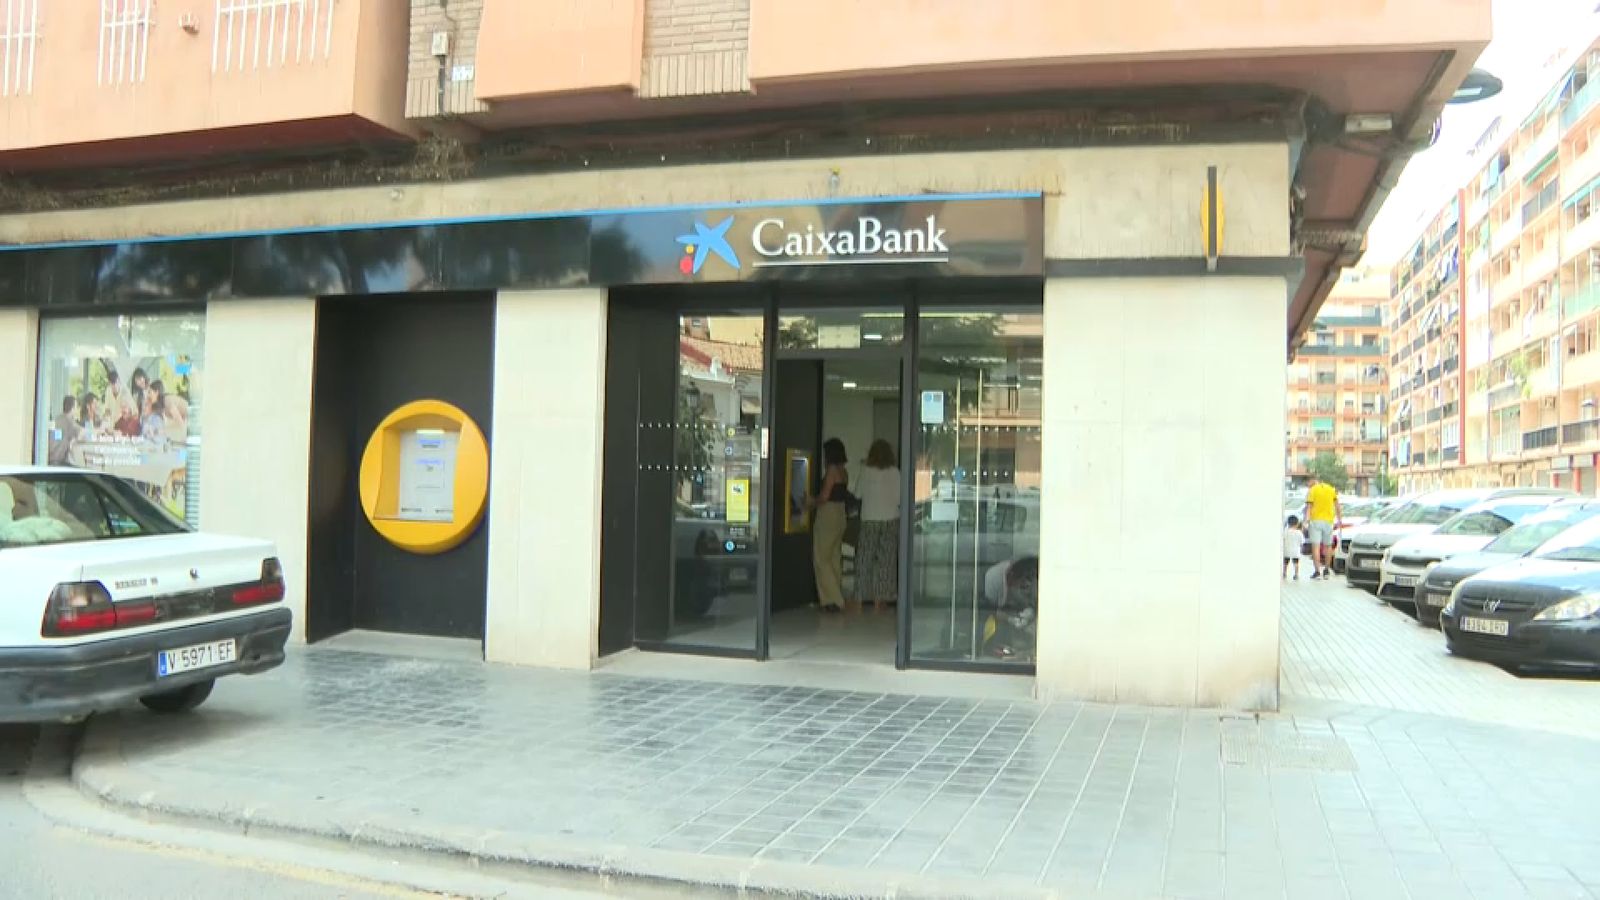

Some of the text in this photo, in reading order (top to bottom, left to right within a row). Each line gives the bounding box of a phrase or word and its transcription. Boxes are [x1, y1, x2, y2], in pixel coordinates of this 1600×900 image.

[752, 215, 949, 256] CaixaBank
[168, 641, 233, 671] V 5971 EF
